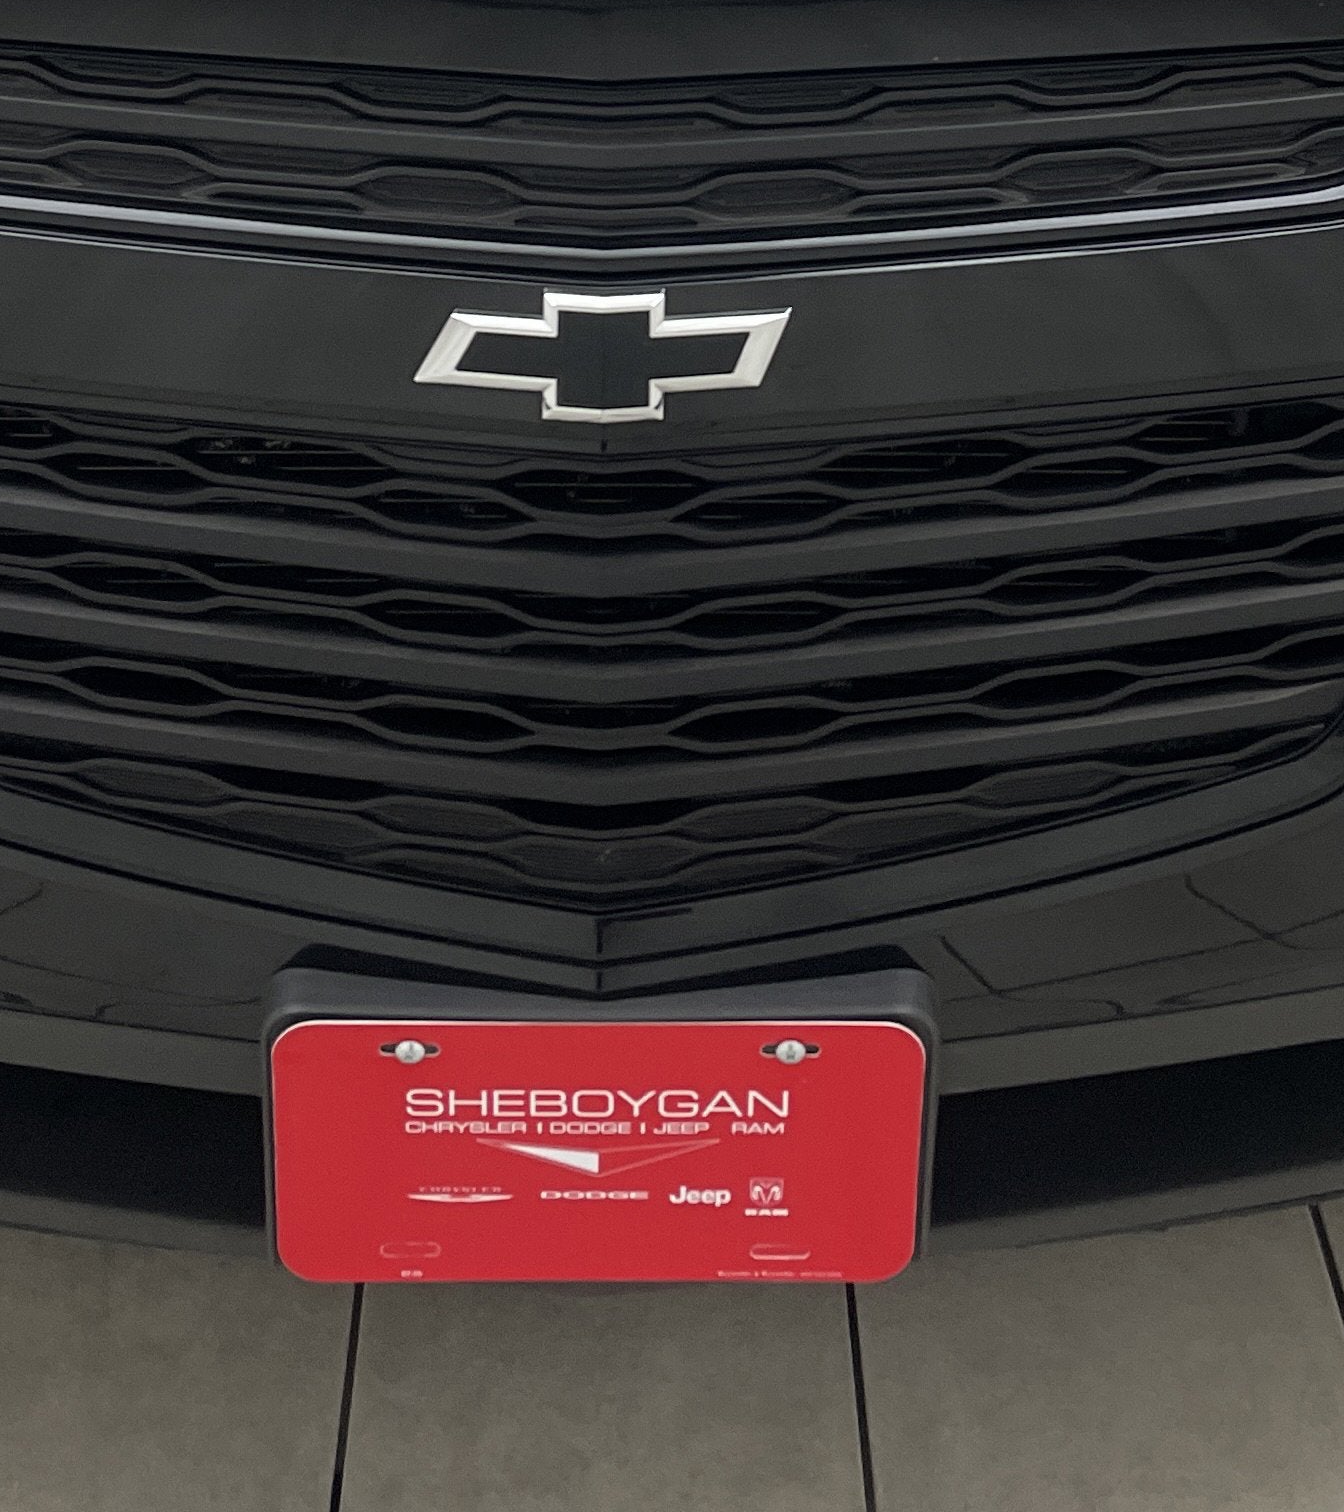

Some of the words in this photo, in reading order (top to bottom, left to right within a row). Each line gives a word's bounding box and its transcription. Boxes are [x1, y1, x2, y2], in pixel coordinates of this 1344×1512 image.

[405, 1088, 790, 1118] SHEBOYGAN
[404, 1120, 528, 1135] CHRYSLER
[549, 1120, 632, 1135] DODGE
[652, 1121, 710, 1135] JEEP
[730, 1121, 785, 1135] RAM
[668, 1185, 732, 1208] Jeep
